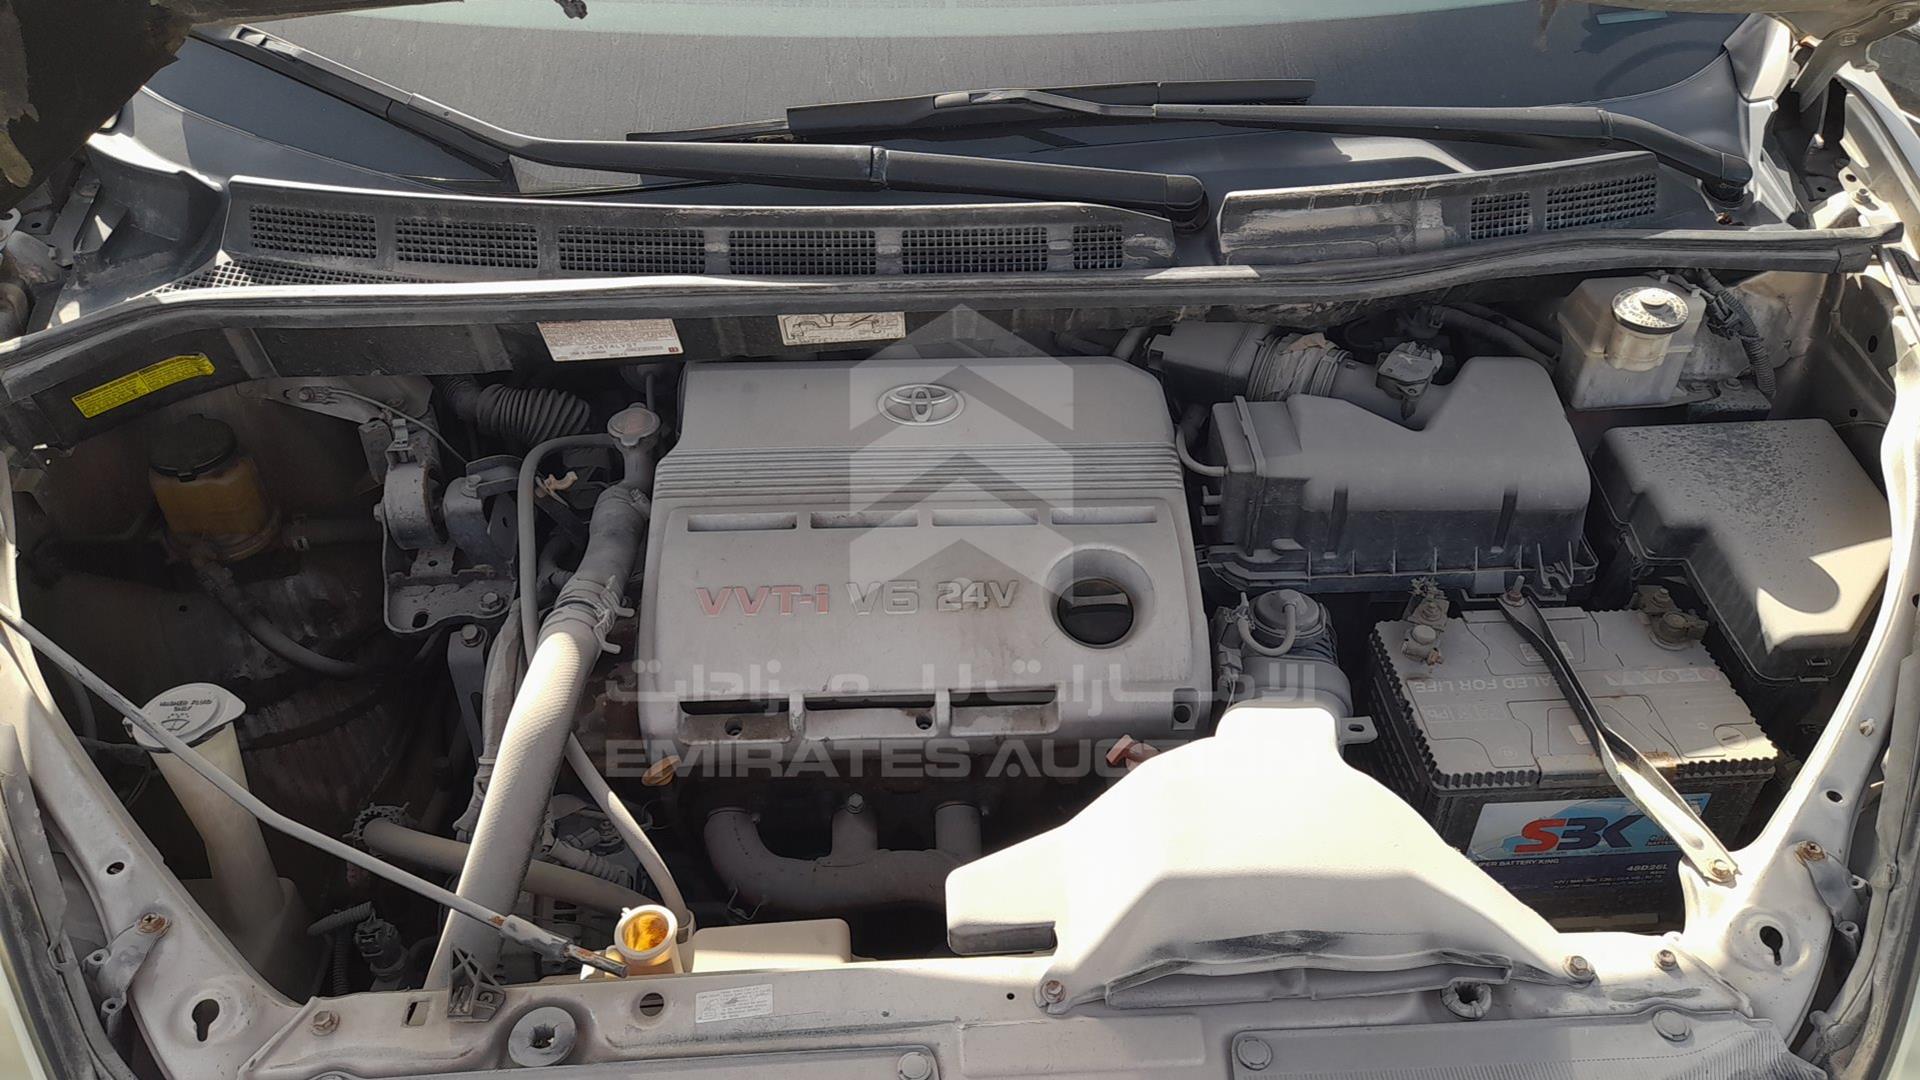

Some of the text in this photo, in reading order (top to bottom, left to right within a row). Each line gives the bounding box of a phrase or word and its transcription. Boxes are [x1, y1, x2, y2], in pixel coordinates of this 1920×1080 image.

[695, 579, 1019, 617] VVT-i V6 24V
[1414, 675, 1557, 694] ALED FOR LIFE
[1514, 815, 1646, 853] SBK
[1537, 857, 1560, 866] KING
